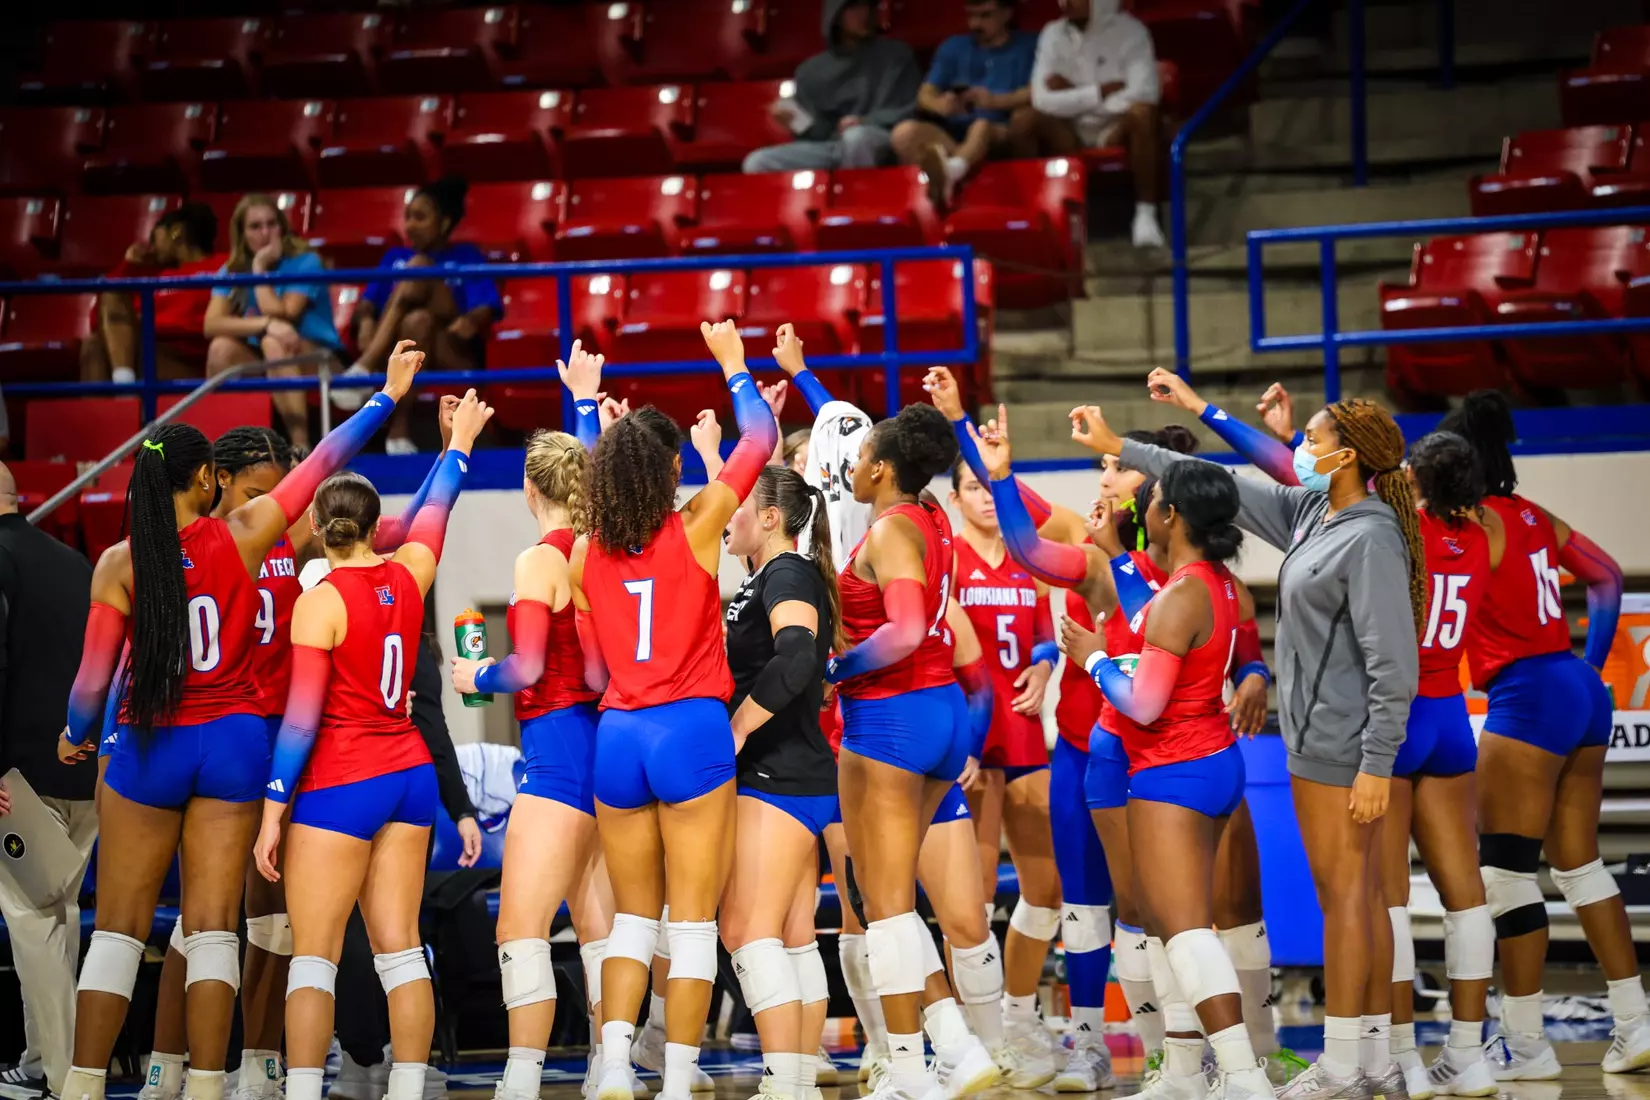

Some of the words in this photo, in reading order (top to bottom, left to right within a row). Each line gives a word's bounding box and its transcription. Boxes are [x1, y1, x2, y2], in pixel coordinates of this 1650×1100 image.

[188, 594, 221, 672] 0
[622, 578, 654, 662] 7
[959, 586, 1018, 607] LOUISIANA
[1018, 587, 1036, 608] TEC
[1421, 573, 1472, 649] 15
[380, 633, 403, 710] 0
[996, 613, 1020, 670] 5
